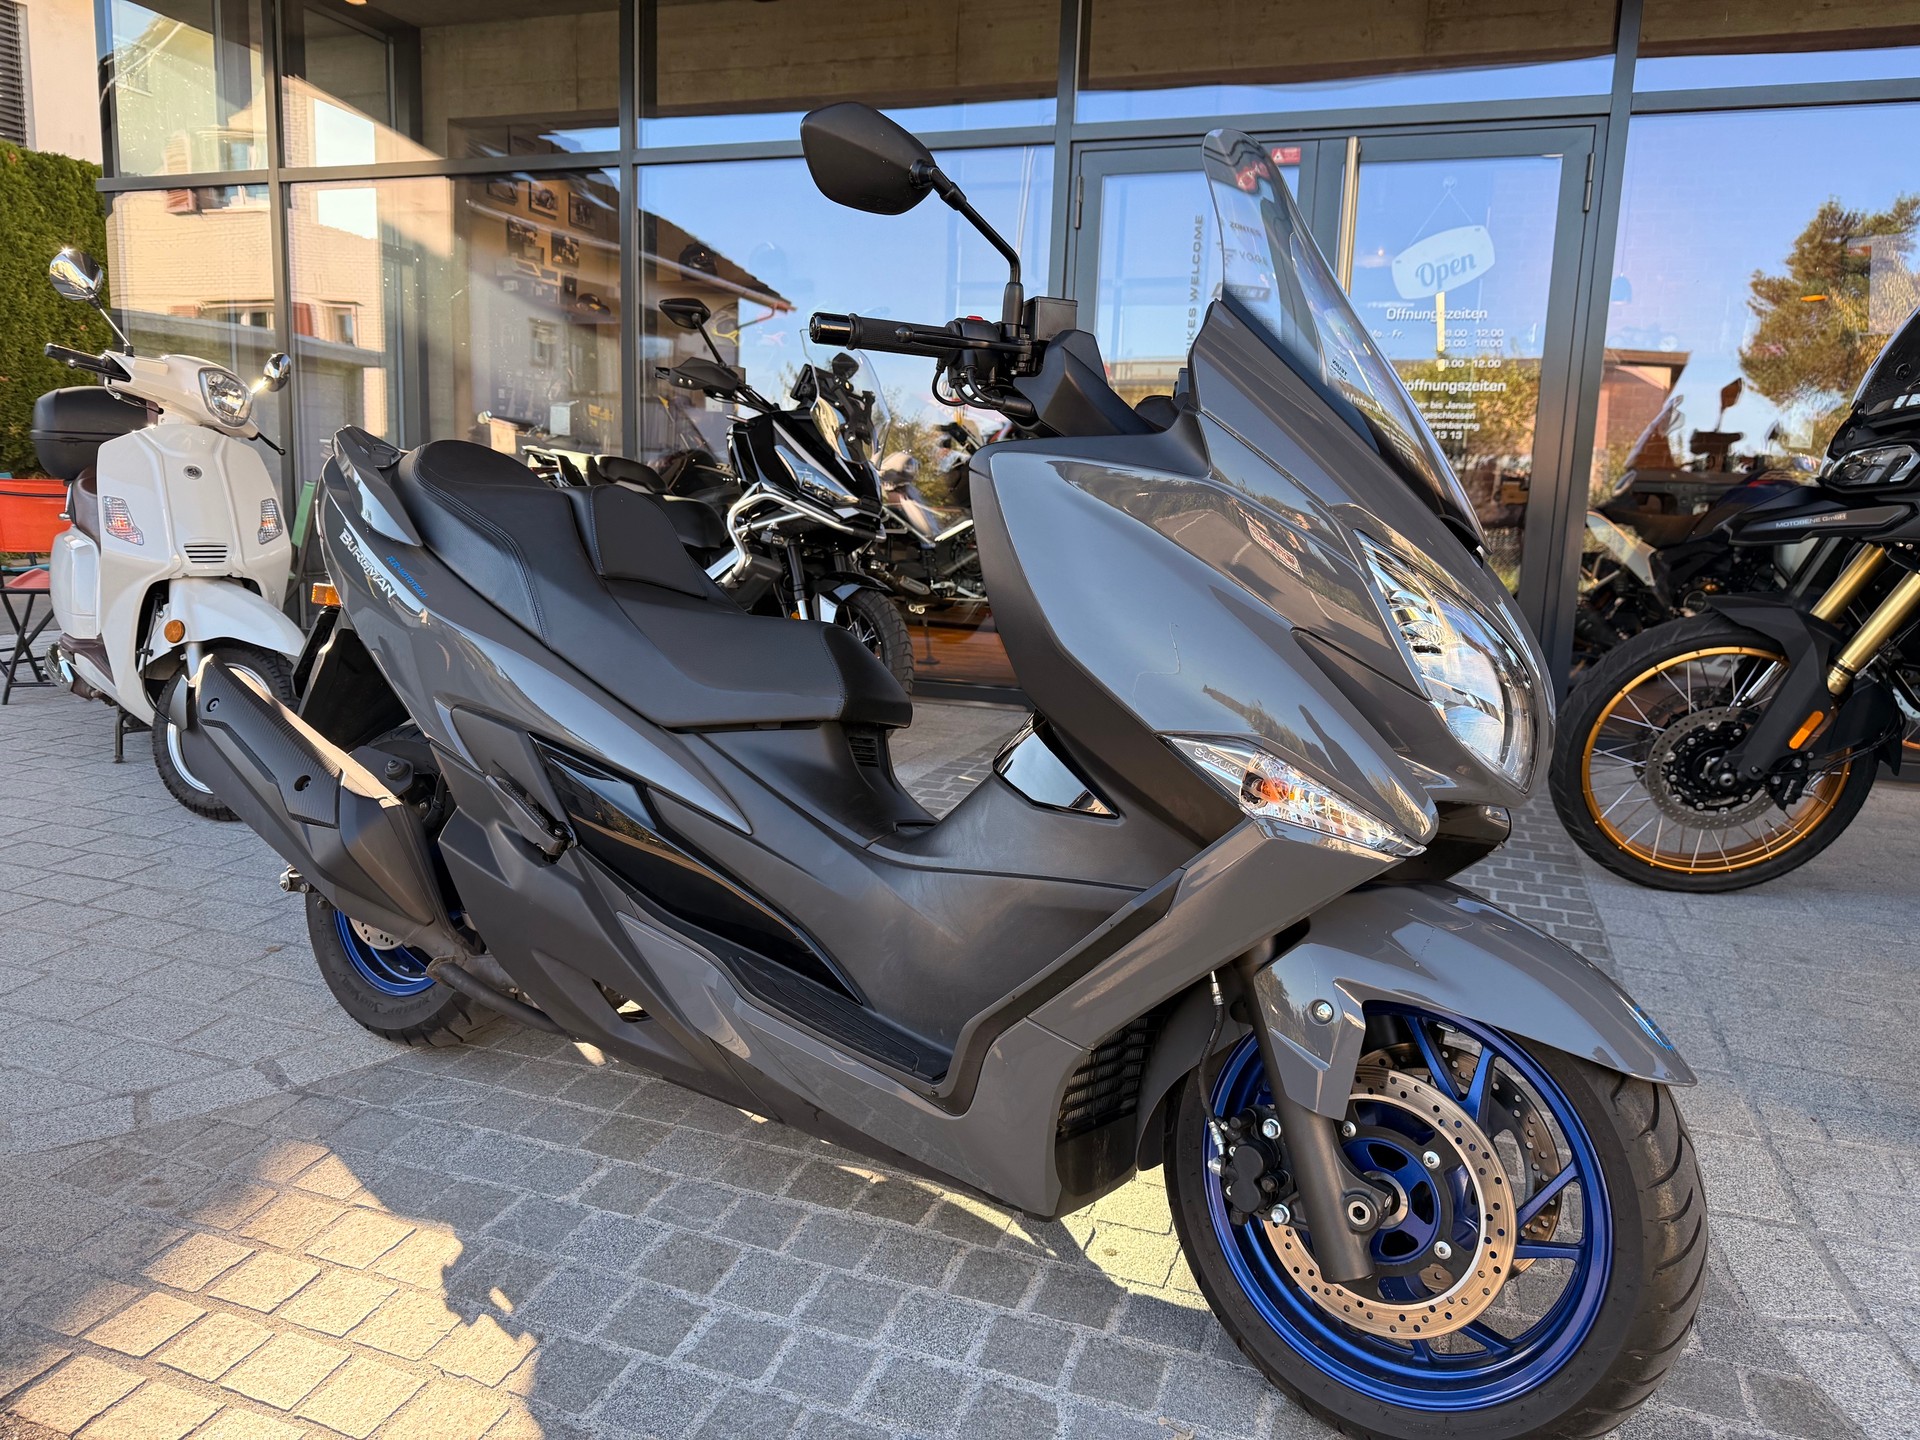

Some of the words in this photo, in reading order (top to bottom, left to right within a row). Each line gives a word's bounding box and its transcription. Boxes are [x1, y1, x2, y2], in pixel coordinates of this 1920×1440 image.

[1189, 214, 1204, 302] WELCOME
[1415, 253, 1477, 290] Open
[1386, 307, 1488, 323] Öffnungzeiten
[1186, 307, 1197, 357] IKES
[1475, 328, 1504, 337] 12.00
[1472, 358, 1502, 368] 12.00
[1430, 400, 1444, 410] bis
[1445, 400, 1477, 410] Januar
[1423, 410, 1476, 421] geschlossen
[1427, 420, 1480, 432] ereinbarung
[1449, 431, 1463, 440] 13
[1822, 512, 1848, 523] GmbH
[339, 528, 397, 598] BURGMAN
[1194, 747, 1242, 777] SUZUKI
